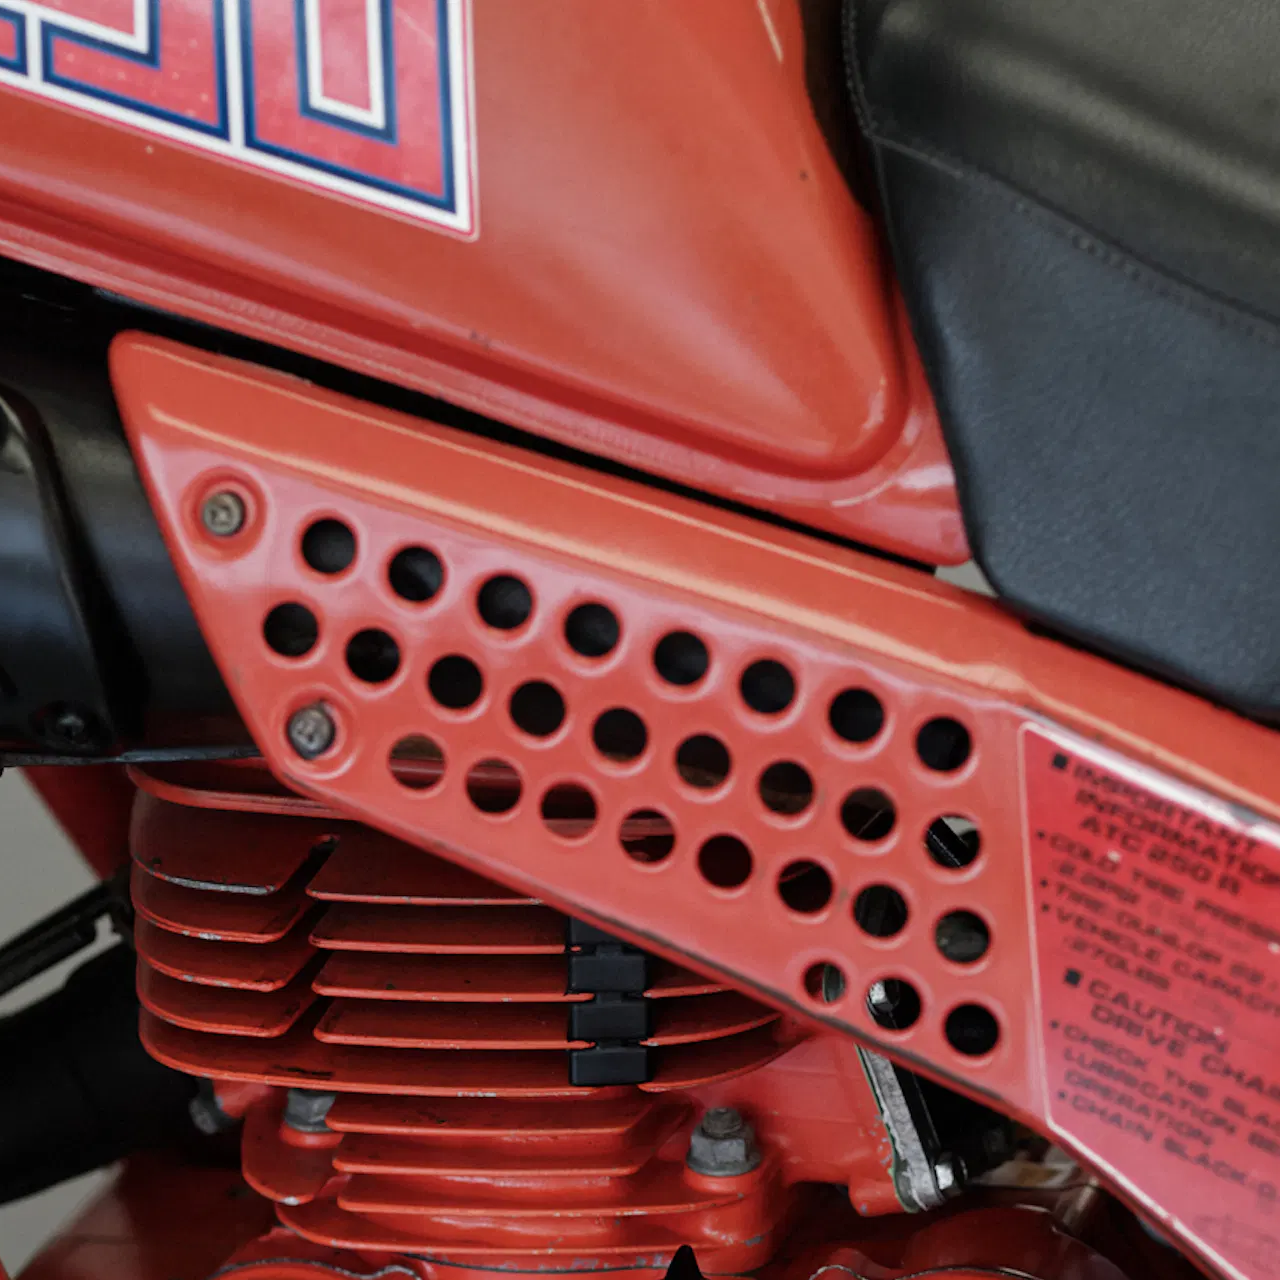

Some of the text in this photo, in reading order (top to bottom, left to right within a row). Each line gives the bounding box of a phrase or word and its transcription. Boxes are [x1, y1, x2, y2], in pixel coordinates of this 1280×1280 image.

[1073, 763, 1260, 855] IMPORTANT
[1088, 979, 1229, 1059] CAUTION
[1090, 1001, 1185, 1058] DRIVE
